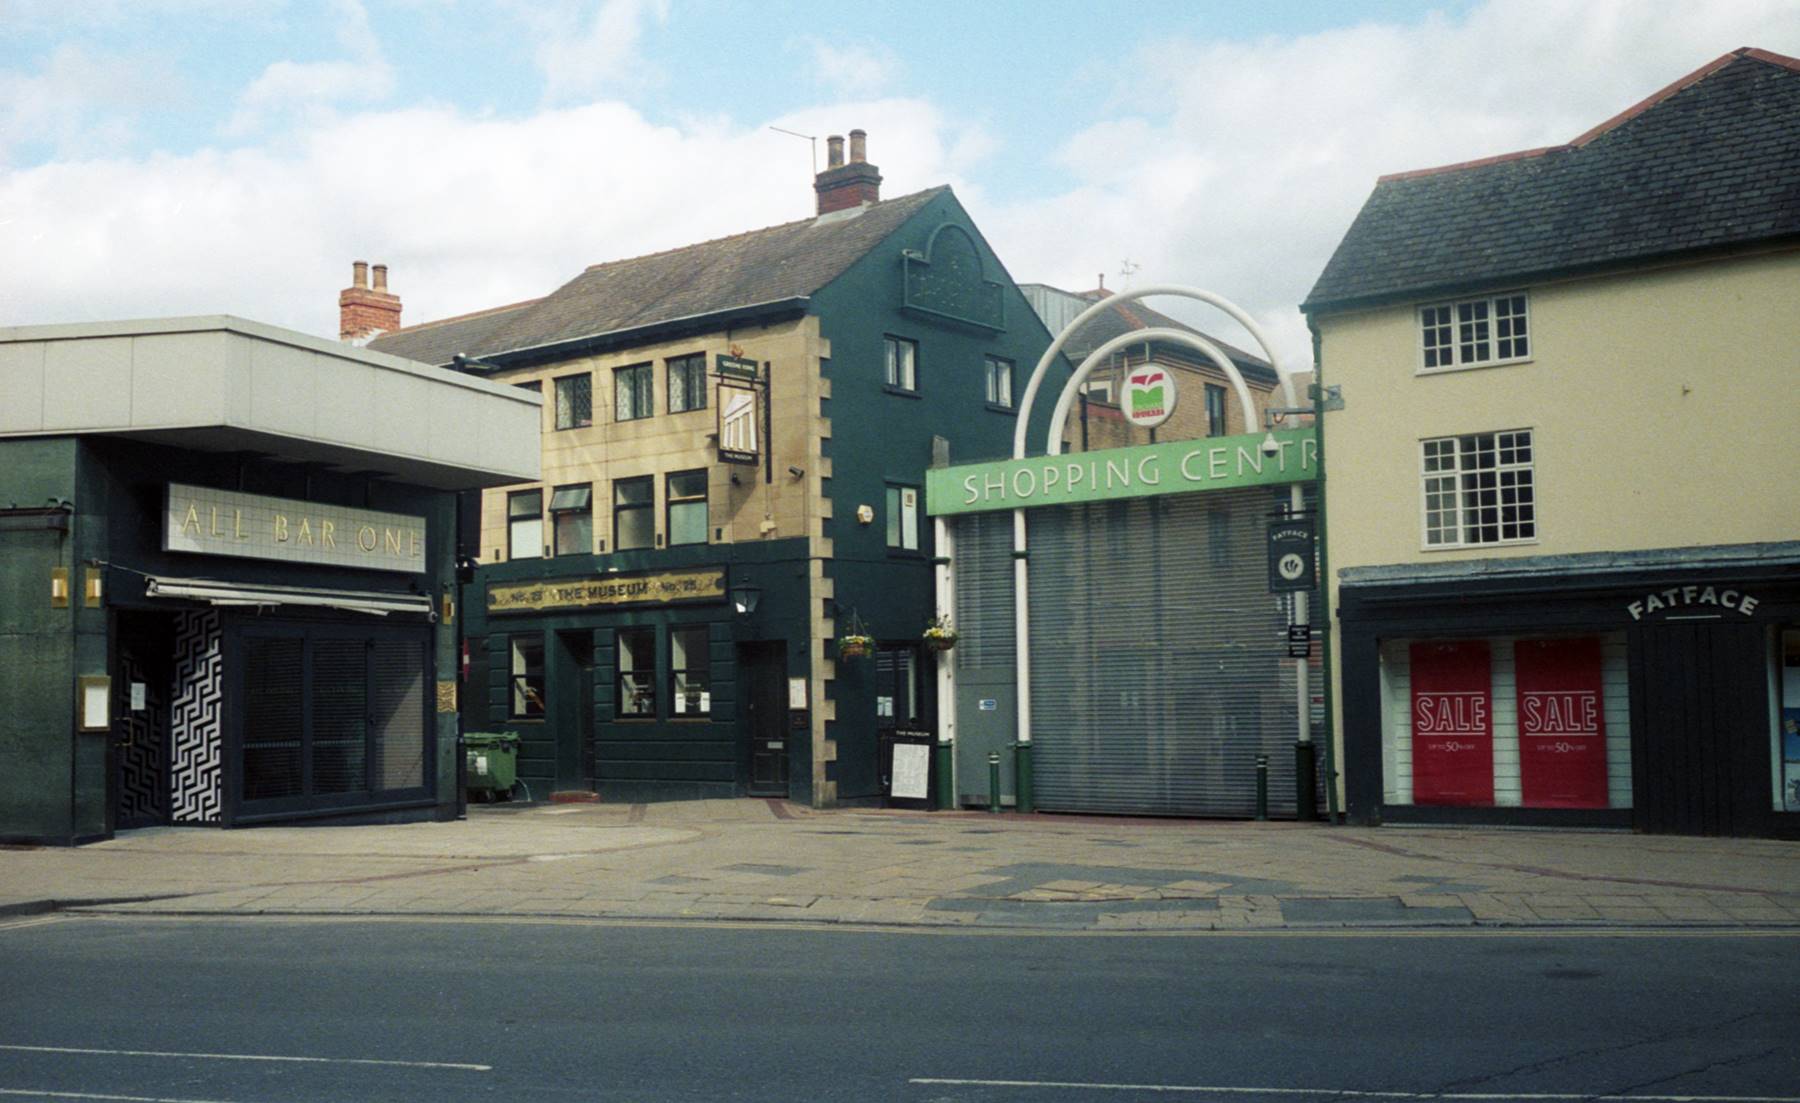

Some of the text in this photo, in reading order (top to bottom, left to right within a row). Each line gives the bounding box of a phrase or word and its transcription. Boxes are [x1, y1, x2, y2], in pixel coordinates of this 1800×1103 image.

[963, 454, 1160, 505] SHOPPING
[182, 503, 421, 558] ALL BAR ONE
[1272, 530, 1309, 541] FATFACE
[557, 588, 583, 600] THE
[588, 582, 649, 598] MUSEUM
[1627, 586, 1760, 621] FATFACE
[1417, 697, 1486, 731] SALE
[1523, 696, 1598, 732] SALE
